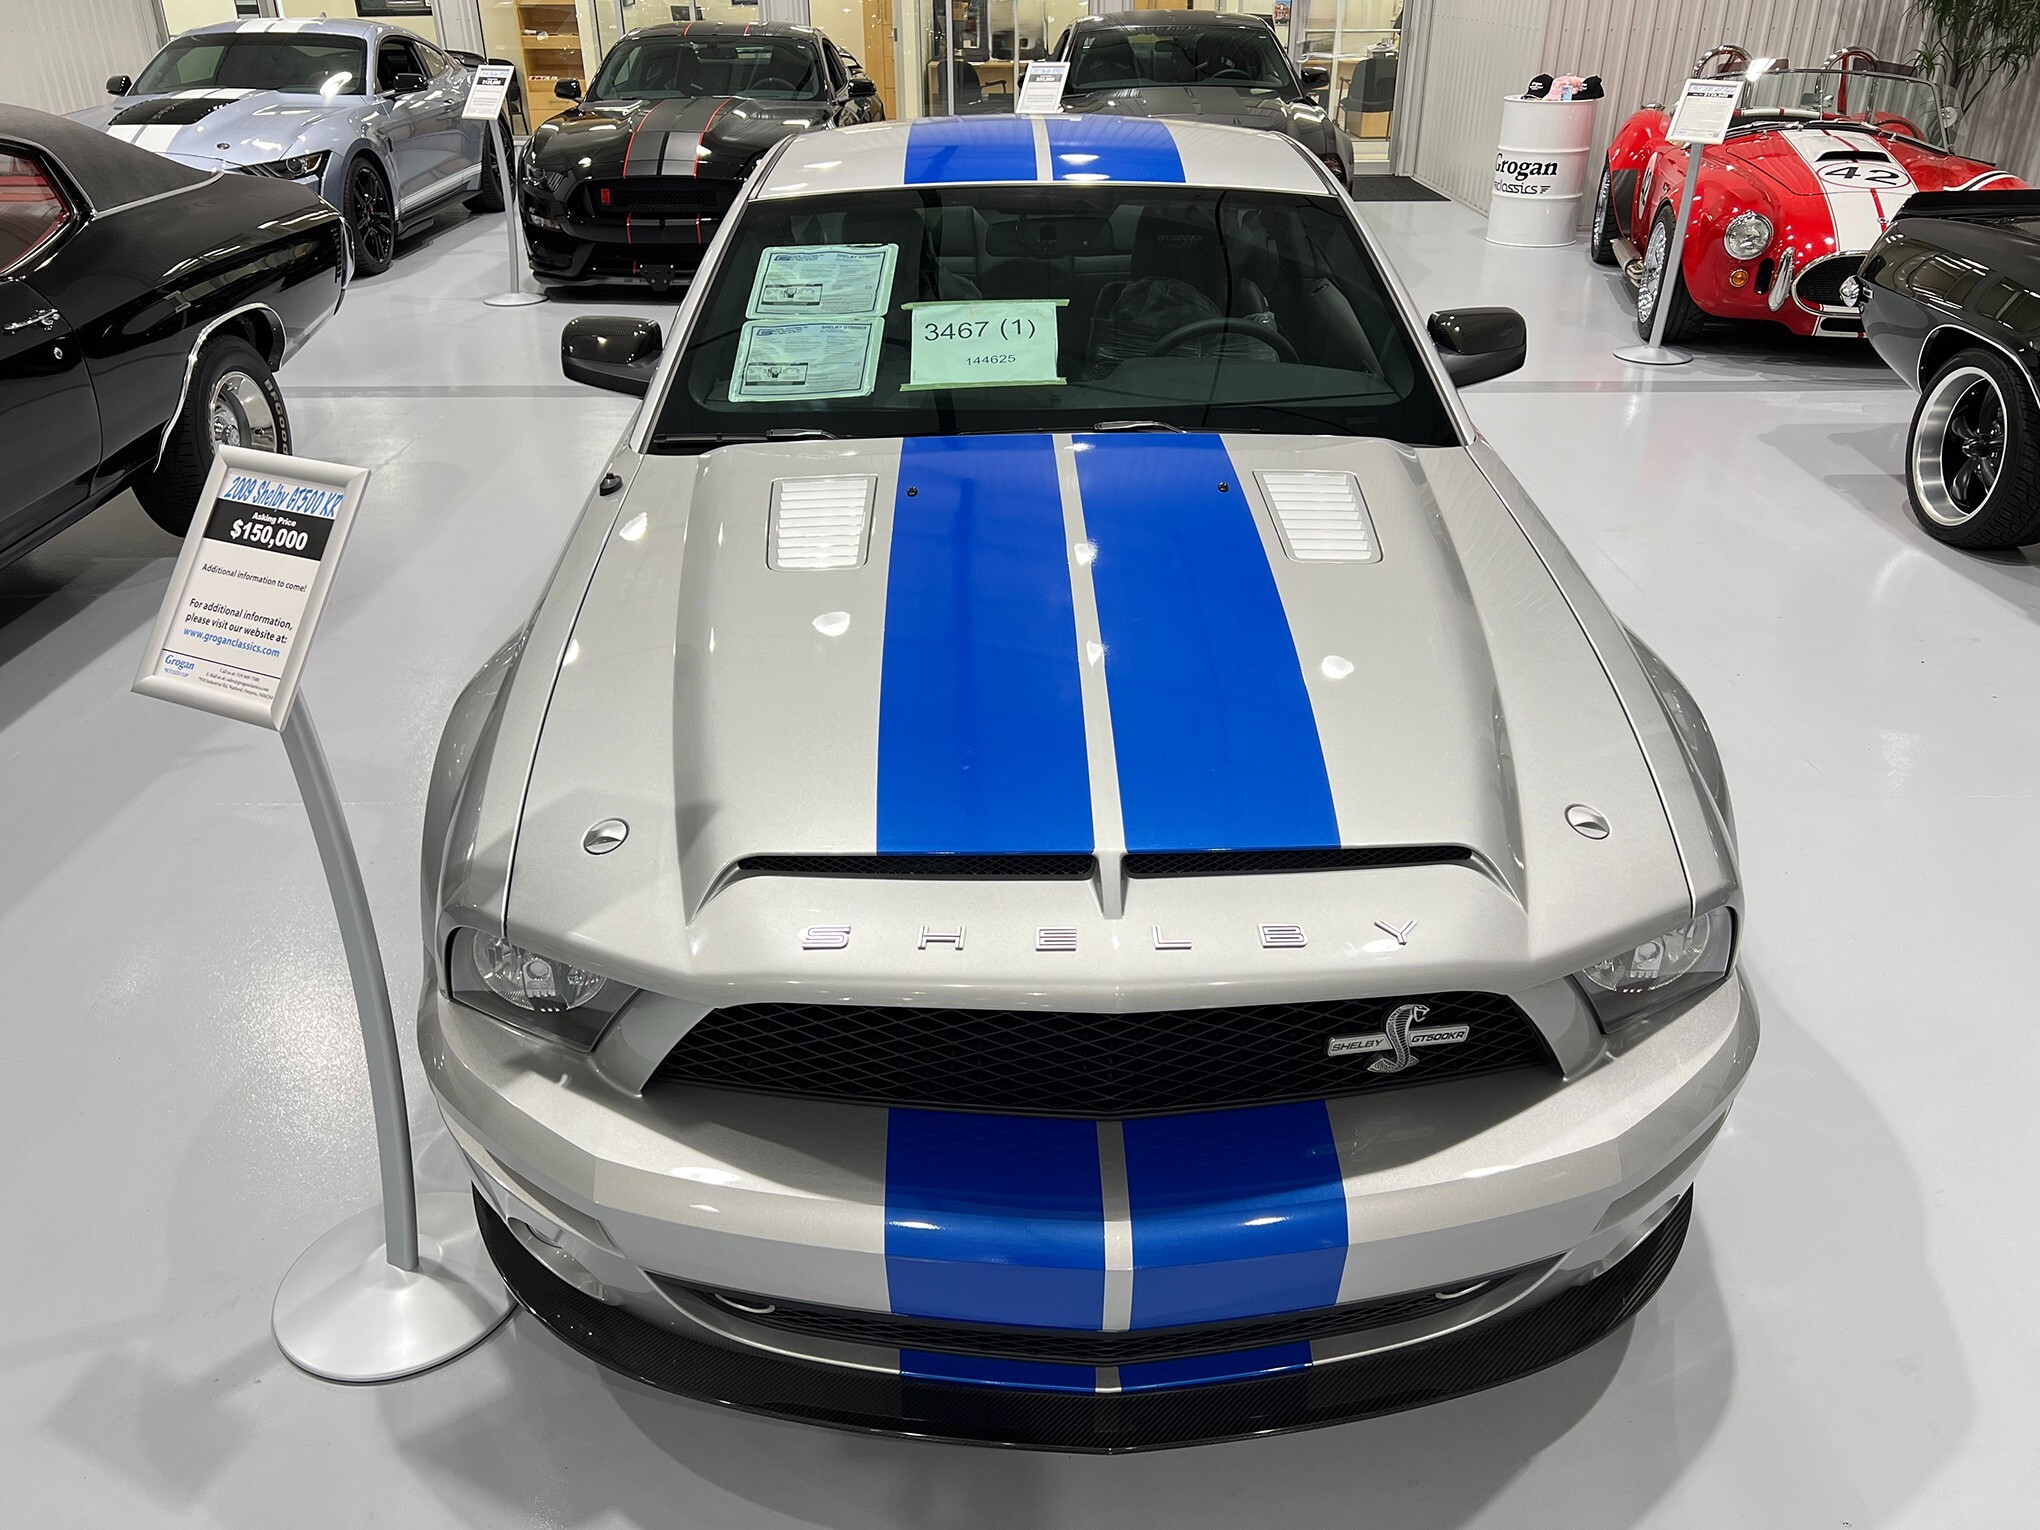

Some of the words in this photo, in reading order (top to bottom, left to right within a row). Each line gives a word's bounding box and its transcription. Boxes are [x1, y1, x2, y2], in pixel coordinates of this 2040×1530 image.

[1495, 152, 1558, 181] Grogan
[1824, 166, 1901, 186] 42
[924, 321, 990, 341] 3467
[1000, 318, 1036, 341] (1)
[965, 354, 1016, 366] 144625
[223, 476, 258, 502] 2009
[252, 480, 289, 512] Shelby
[286, 487, 325, 515] GT500
[252, 512, 276, 525] Asking
[277, 515, 297, 527] Price
[229, 519, 309, 551] $150,000
[202, 563, 237, 578] Additional
[237, 571, 276, 586] information
[277, 579, 285, 589] to
[285, 583, 308, 593] come!
[185, 613, 211, 626] please
[211, 619, 229, 630] visit
[228, 623, 243, 634] our
[243, 626, 275, 642] website
[275, 634, 288, 644] at:
[189, 598, 202, 609] For
[203, 601, 243, 618] additional
[243, 609, 293, 631] information,
[183, 627, 281, 658] www.groganclassics.com
[164, 654, 195, 670] Grogan
[800, 919, 1419, 951] SHELBY
[1331, 1038, 1384, 1052] SHELBY
[1411, 1030, 1466, 1043] GT500KR
